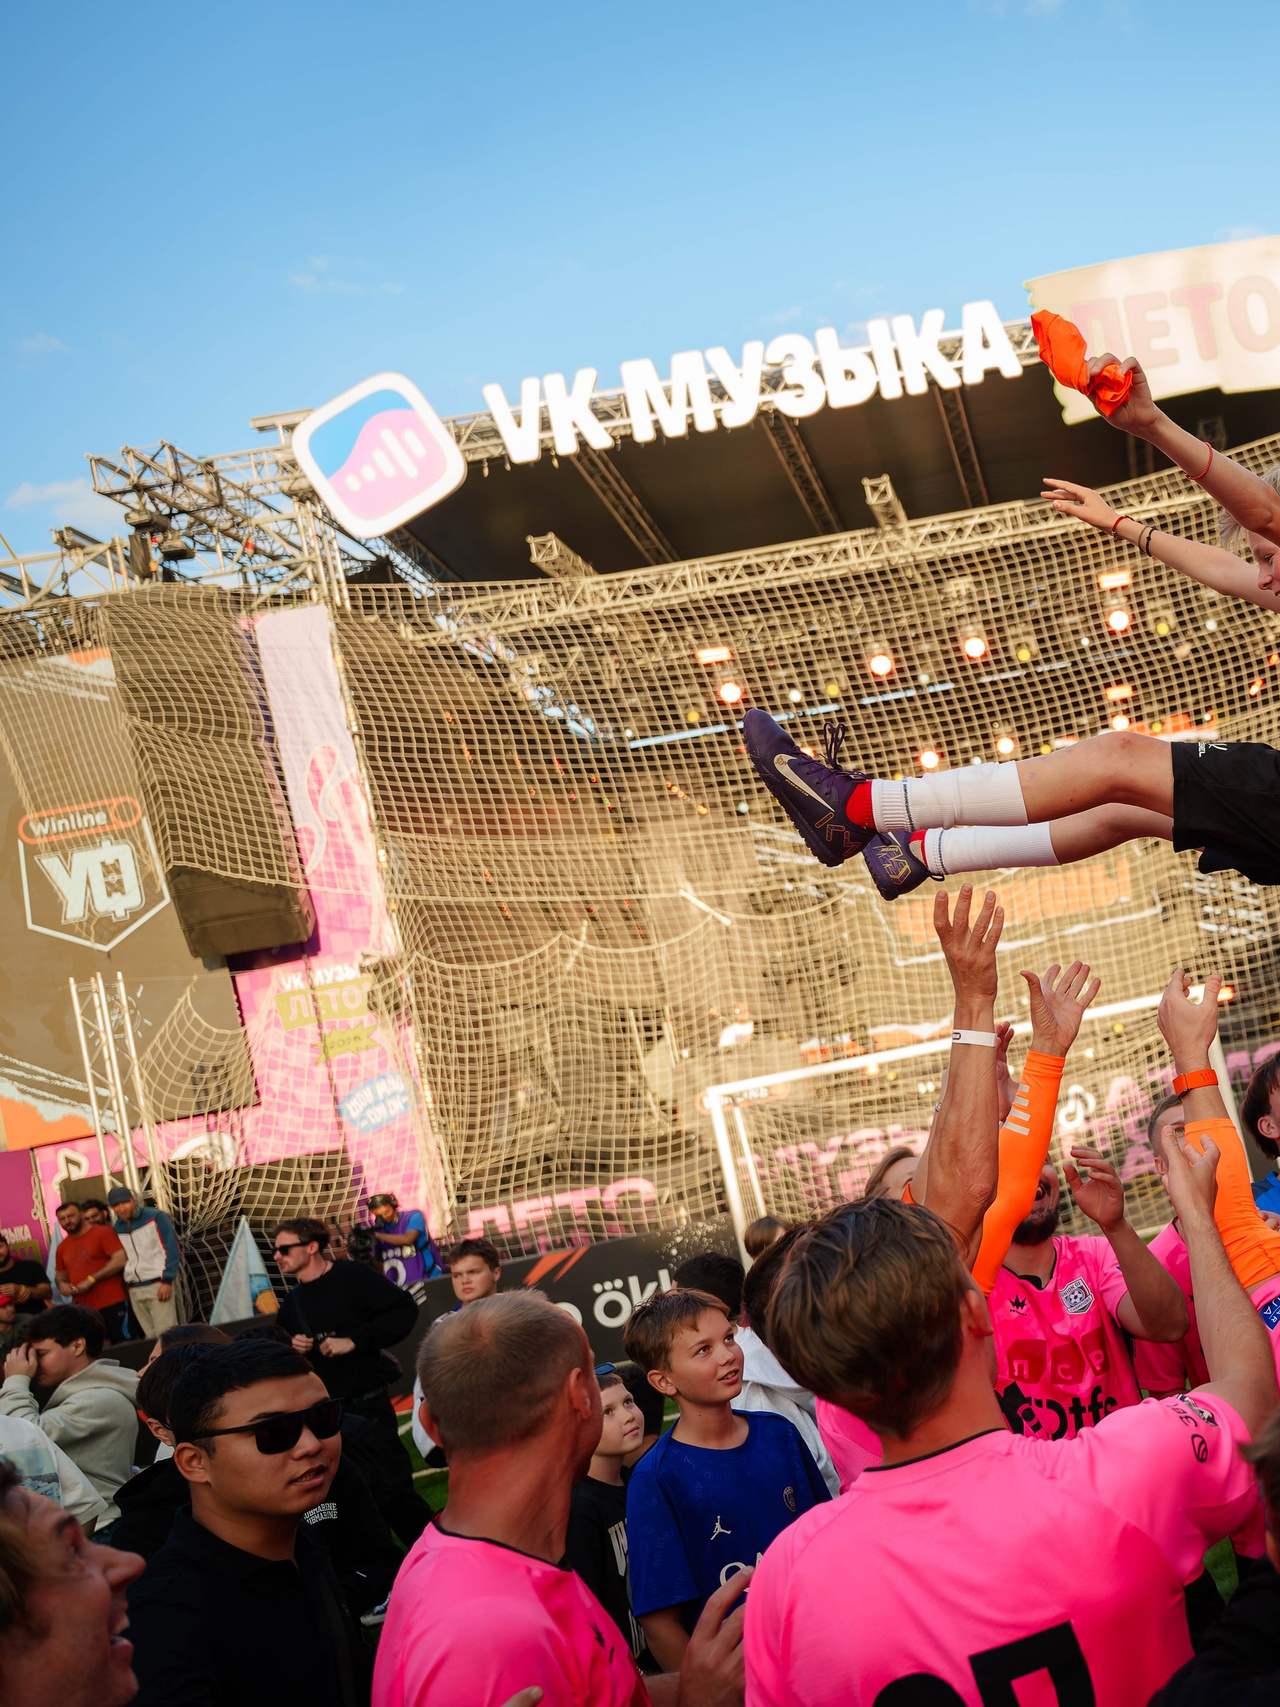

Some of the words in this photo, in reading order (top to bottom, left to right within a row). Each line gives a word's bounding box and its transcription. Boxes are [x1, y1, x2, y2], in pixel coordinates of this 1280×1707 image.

[483, 367, 614, 464] VK
[620, 300, 1023, 444] МУЗЫКА
[29, 810, 108, 838] Winline
